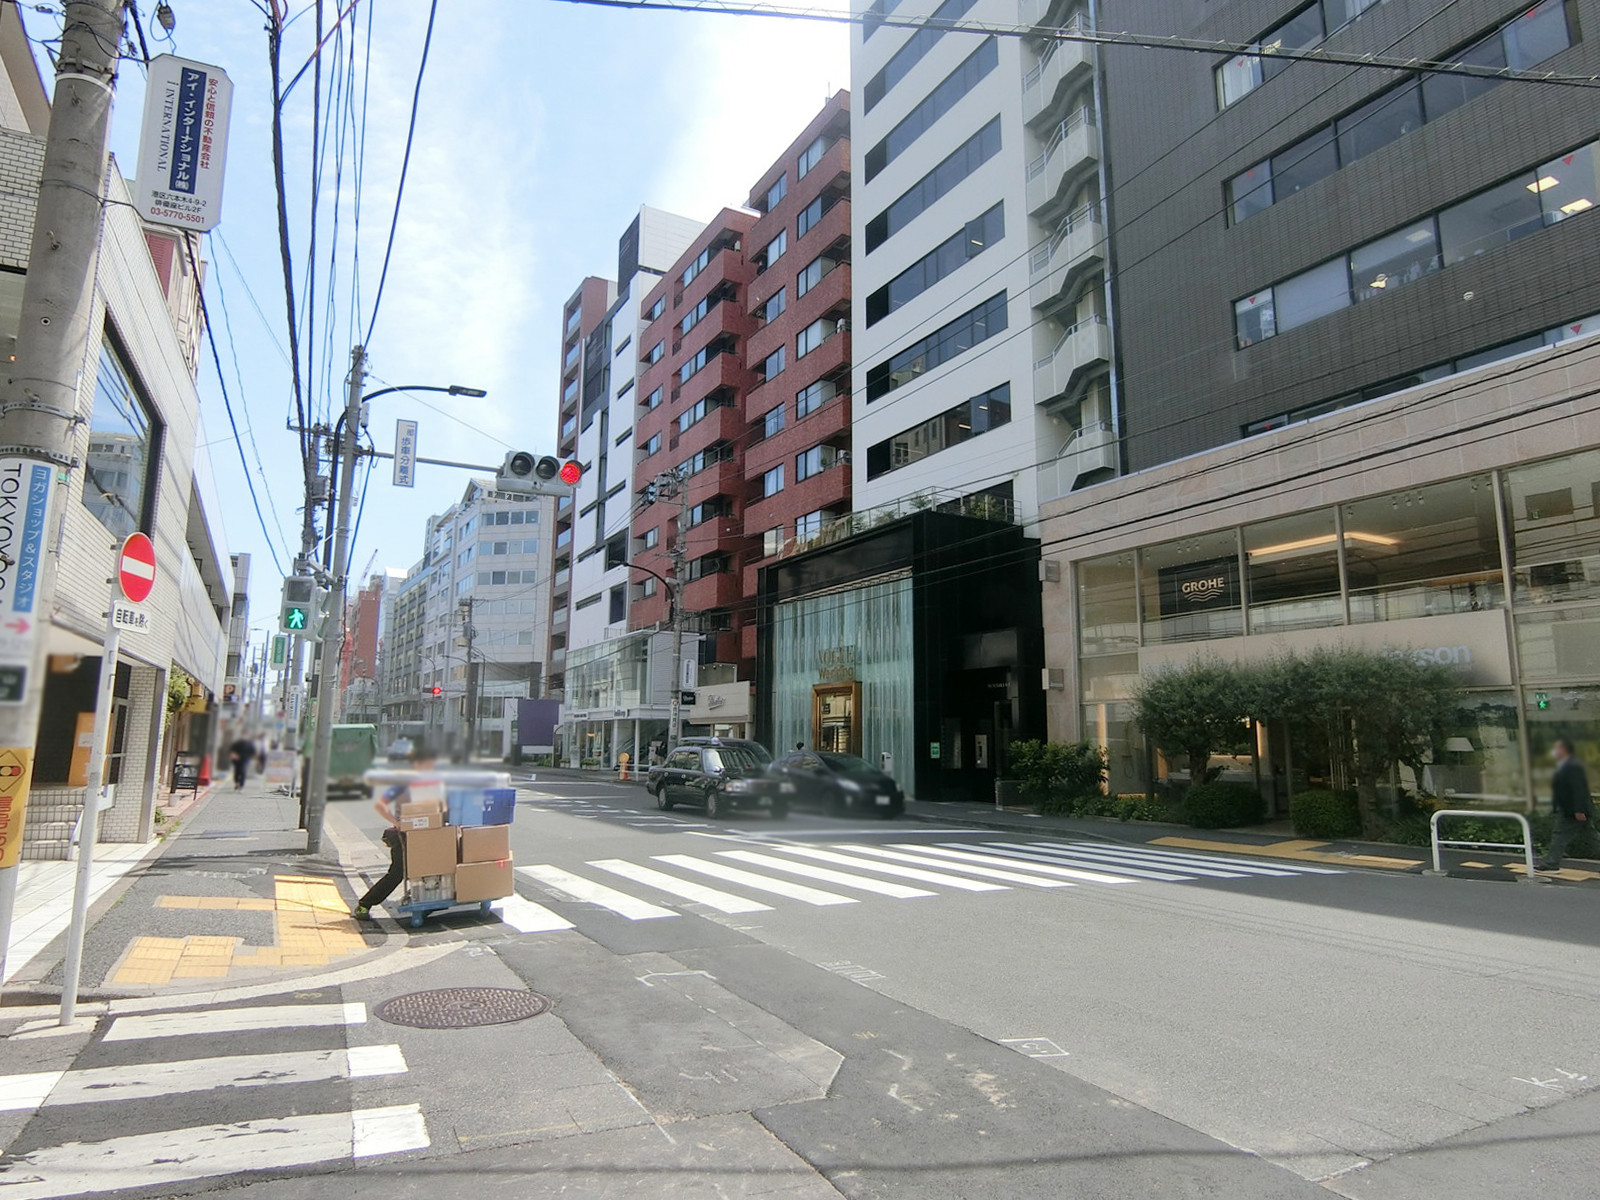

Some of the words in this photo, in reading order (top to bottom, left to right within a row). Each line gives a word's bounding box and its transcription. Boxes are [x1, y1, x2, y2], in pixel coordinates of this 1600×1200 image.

[157, 88, 175, 172] INTERNATIONAL
[200, 78, 218, 169] 安心と信頼の不動産会社
[150, 207, 205, 223] 03-5770-5501
[151, 190, 207, 207] 港区六本木4-9-2
[399, 437, 411, 484] 歩車分離式
[16, 469, 47, 608] ヨガショップ&スタジオ
[1181, 577, 1224, 593] GROHE
[116, 608, 148, 629] 自転車を除く
